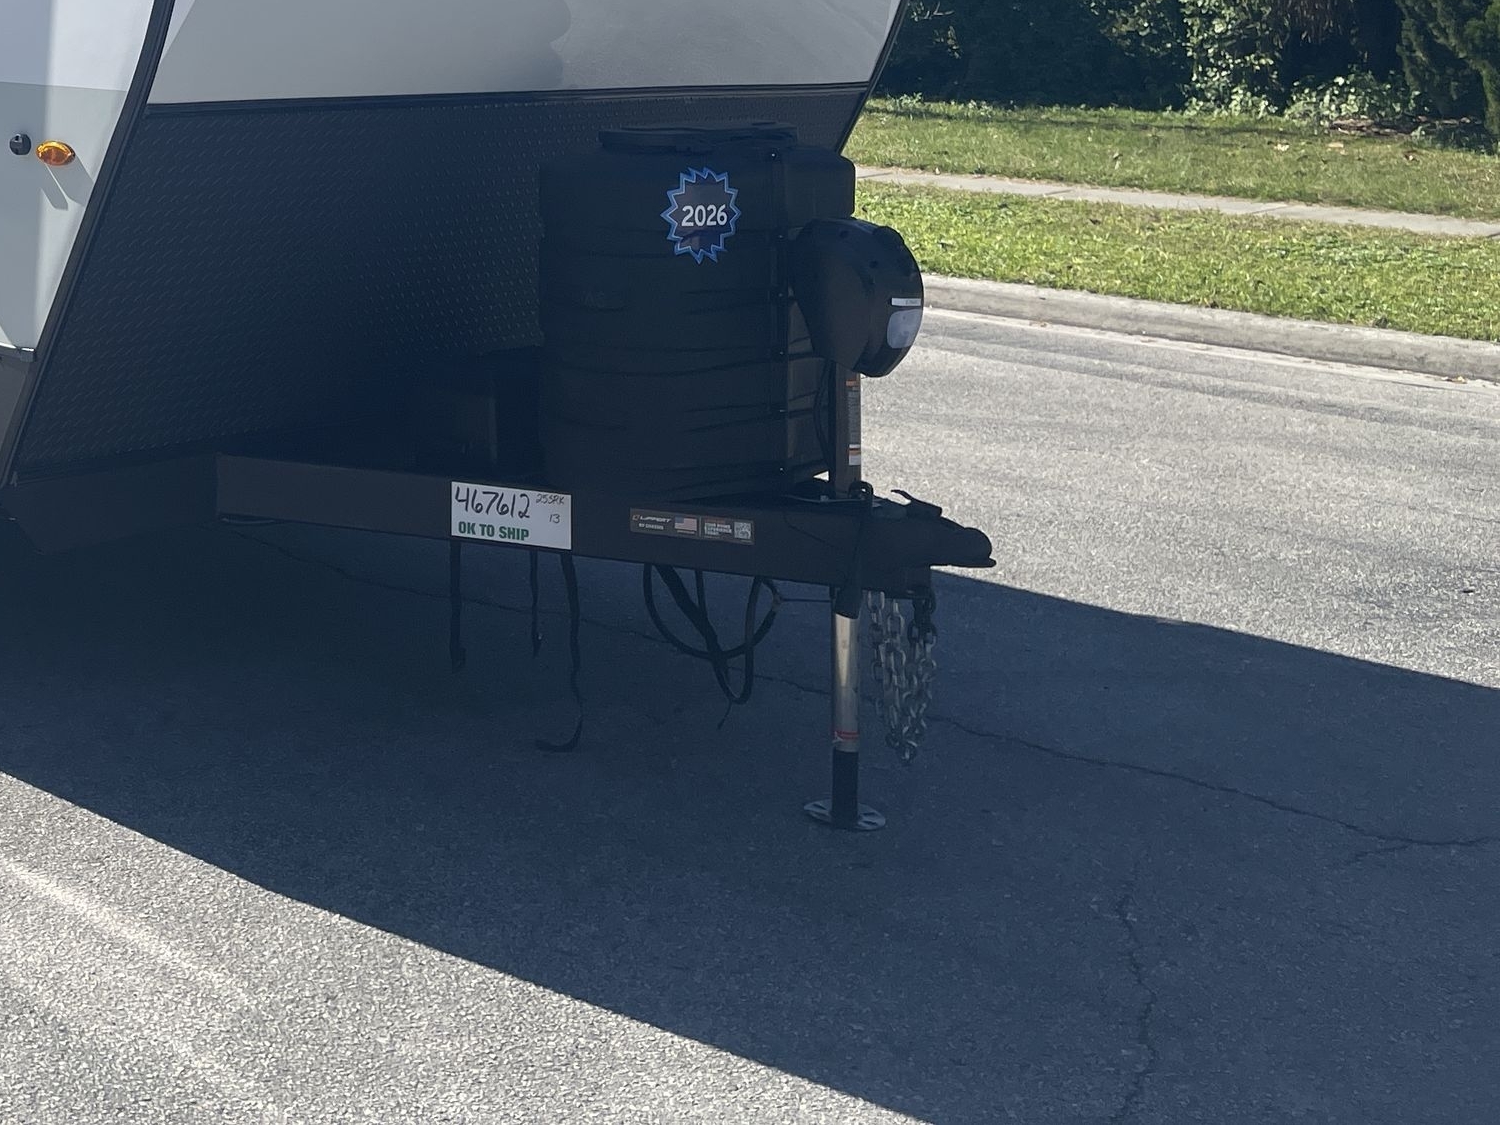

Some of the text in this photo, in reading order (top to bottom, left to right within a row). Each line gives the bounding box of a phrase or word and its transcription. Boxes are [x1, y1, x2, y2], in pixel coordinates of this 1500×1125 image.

[681, 204, 727, 226] 2026
[455, 486, 530, 519] 467612
[549, 513, 560, 523] 13
[458, 521, 529, 541] OK TO SHIP
